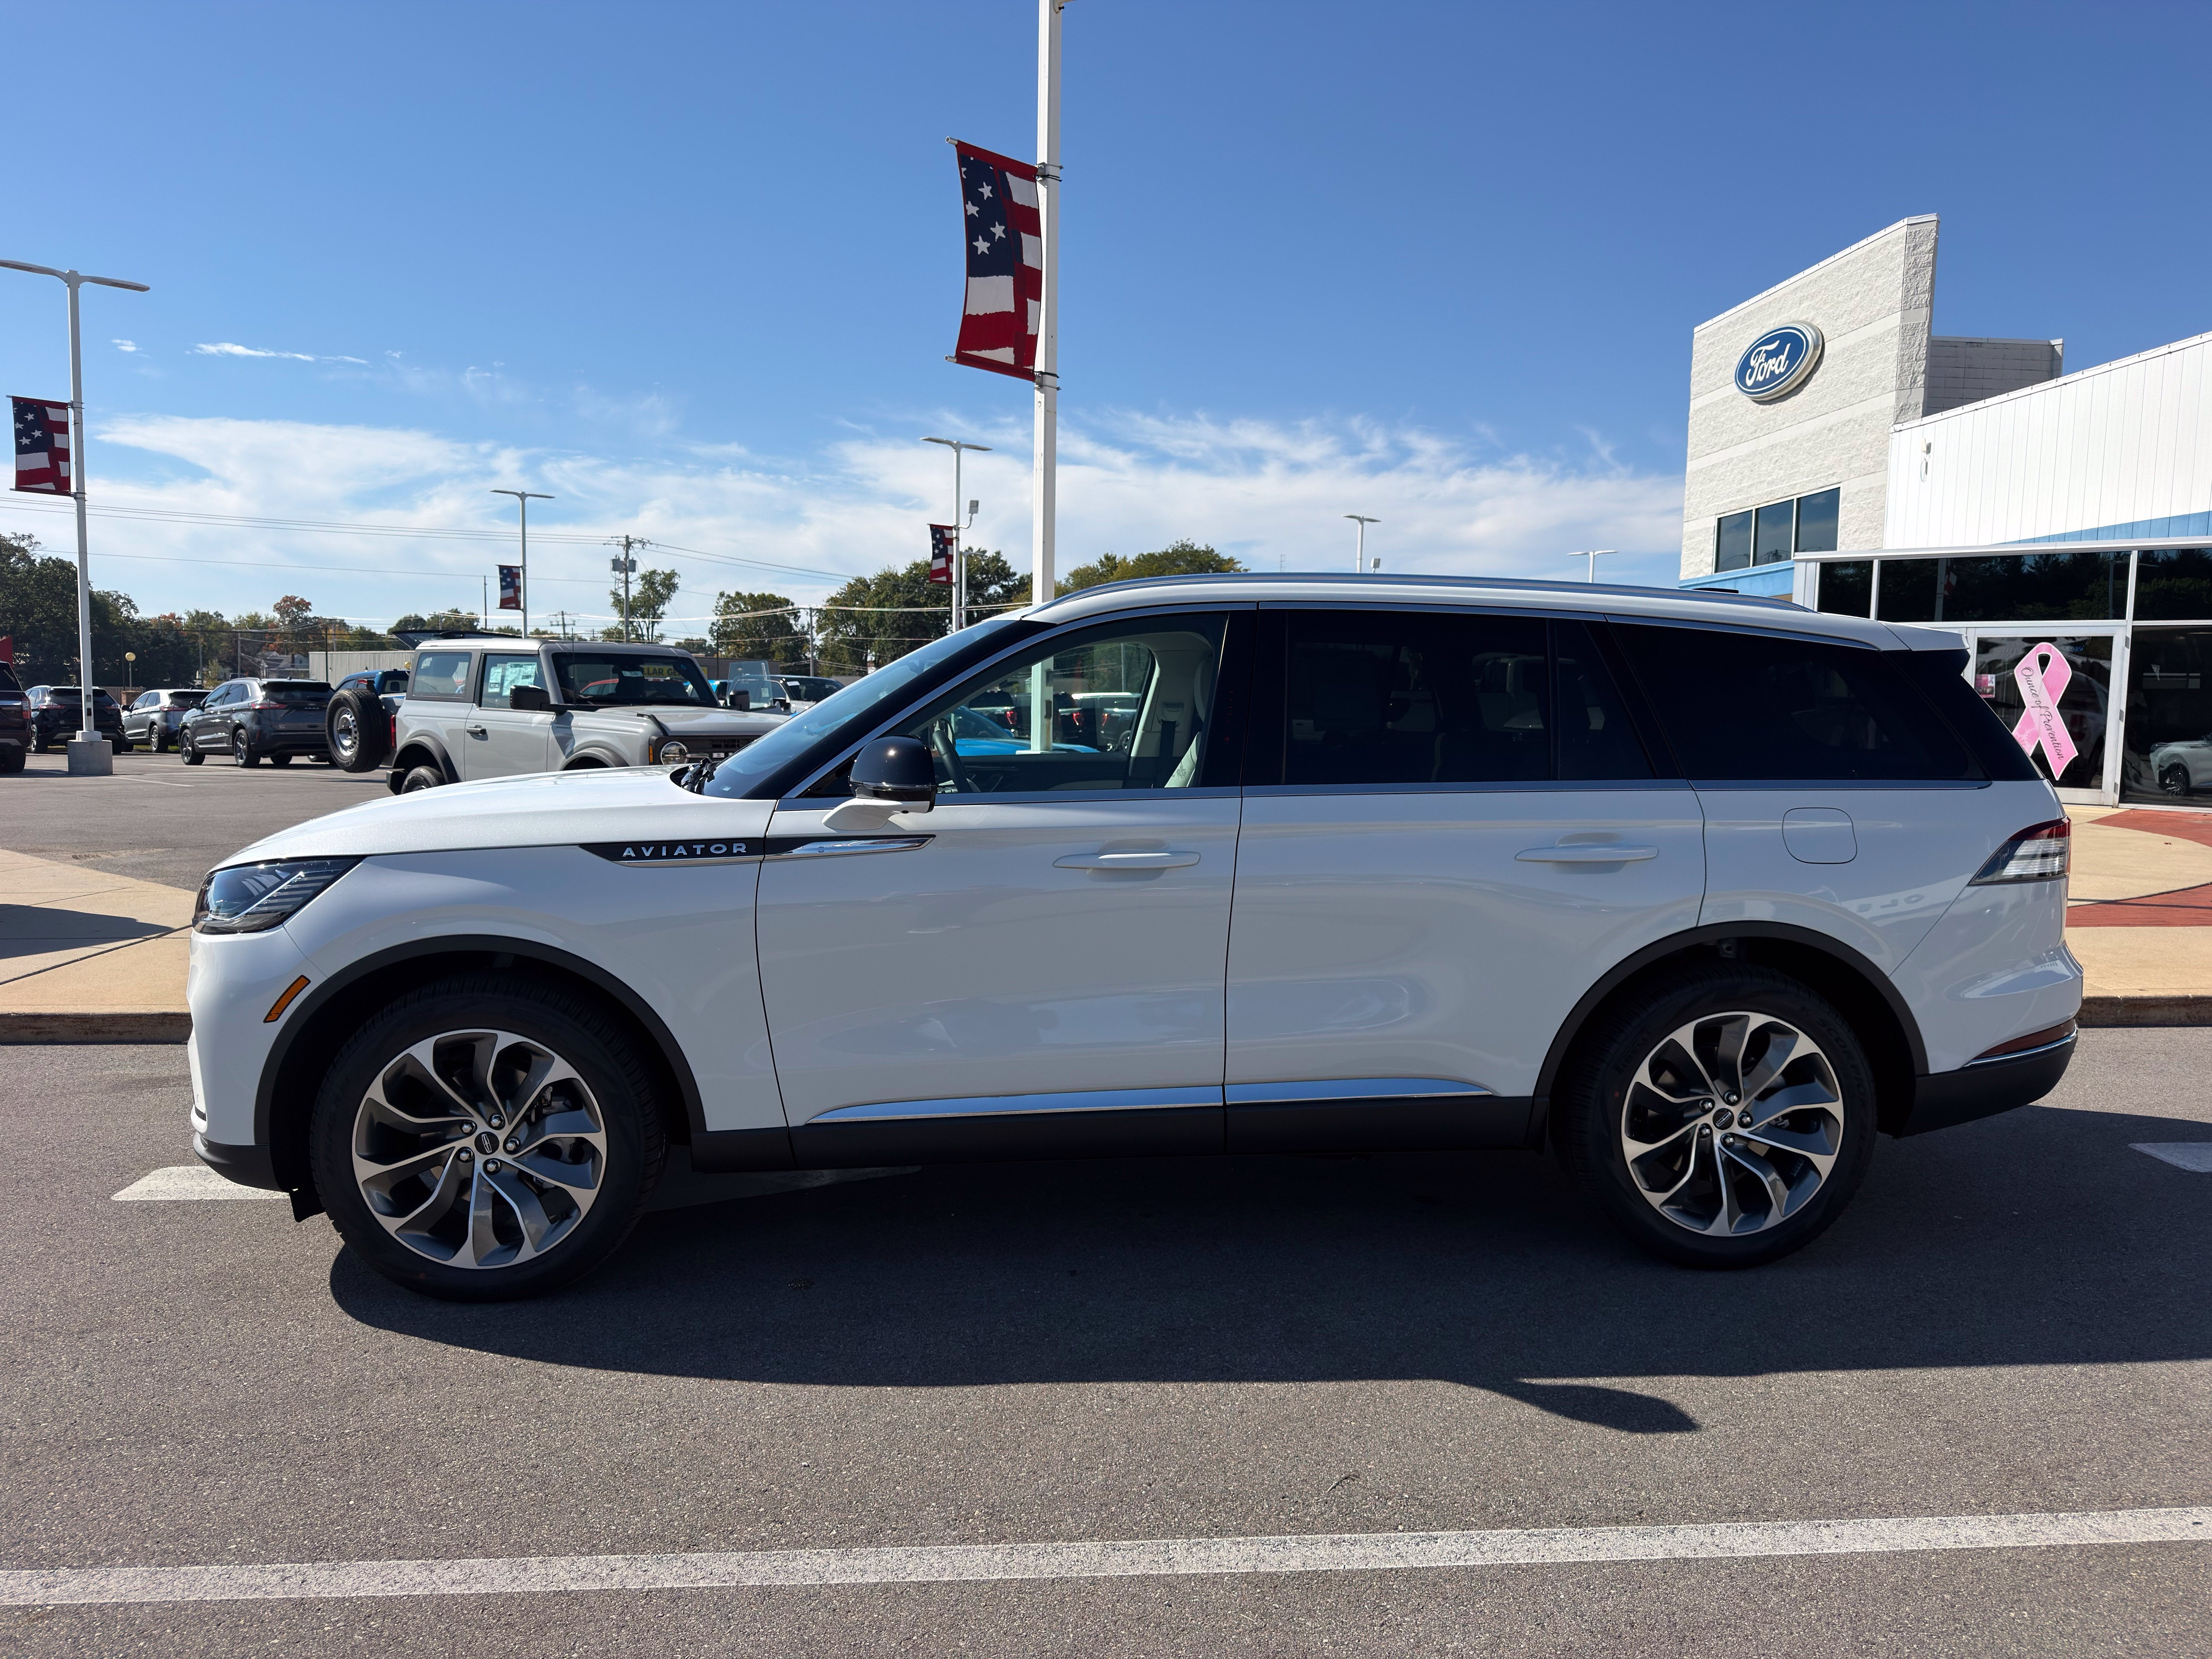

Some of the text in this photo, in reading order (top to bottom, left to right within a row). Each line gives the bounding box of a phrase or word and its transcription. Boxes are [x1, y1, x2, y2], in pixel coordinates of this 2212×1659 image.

[1746, 340, 1791, 386] Ford
[2021, 667, 2064, 760] Ounce of Prevention
[622, 843, 747, 857] AVIATOR
